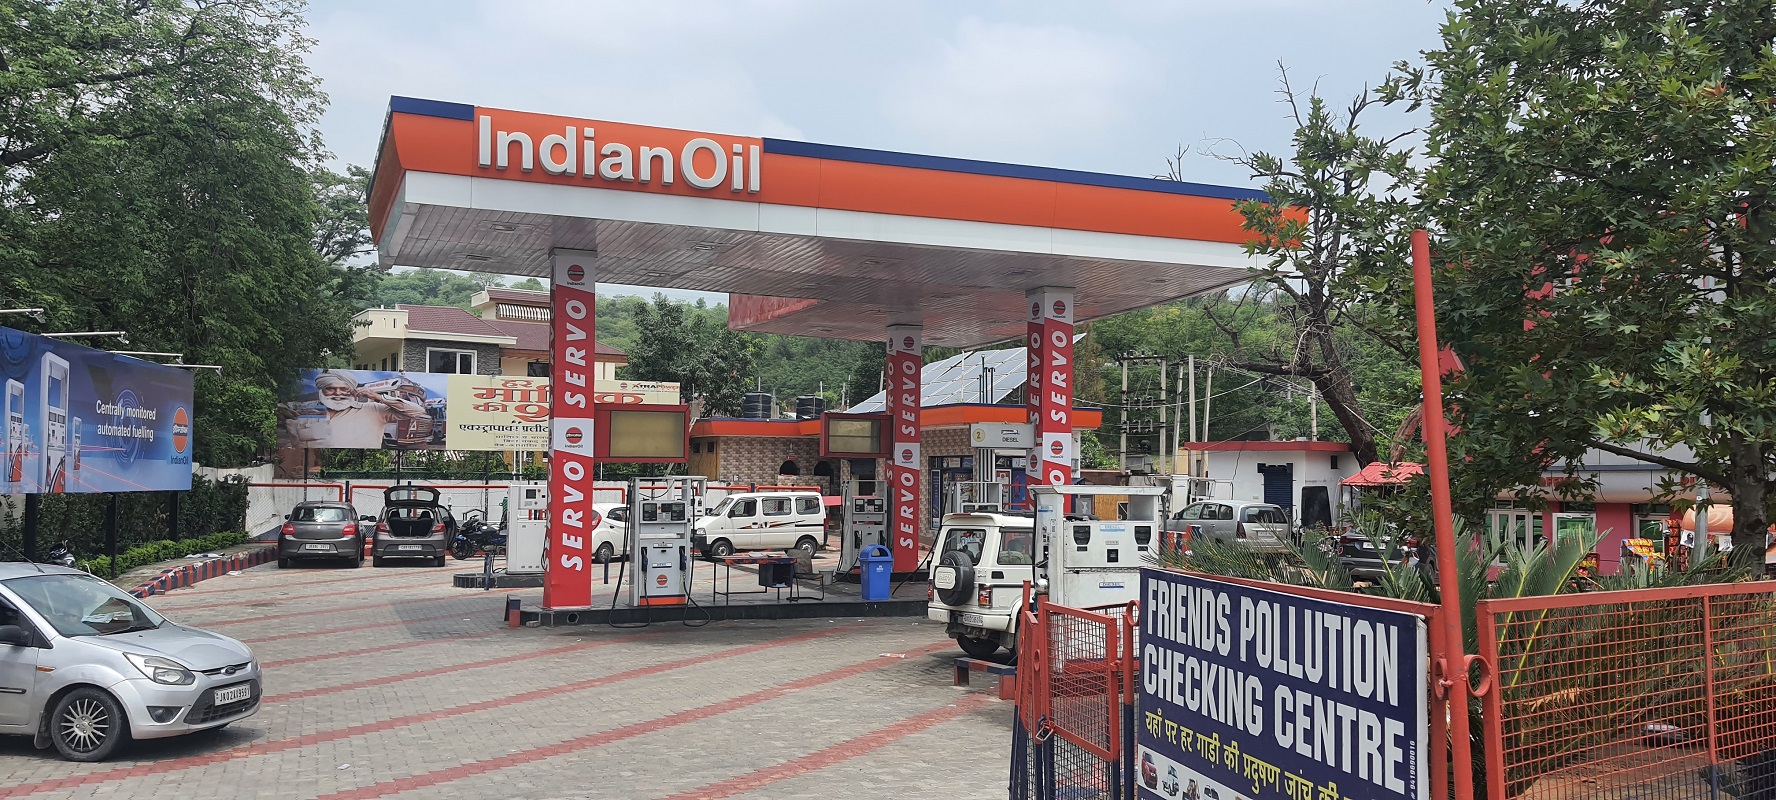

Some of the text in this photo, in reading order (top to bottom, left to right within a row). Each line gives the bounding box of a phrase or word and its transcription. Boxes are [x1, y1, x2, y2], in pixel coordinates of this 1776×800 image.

[478, 115, 760, 193] IndianOil
[501, 379, 534, 388] हर
[565, 300, 587, 409] SERVO
[1030, 332, 1041, 425] SERVO
[1051, 330, 1067, 424] SERVO
[96, 400, 156, 420] Centrally monitored
[97, 423, 154, 442] automated fuelling
[472, 401, 509, 412] की
[902, 361, 916, 437] SERVO
[976, 431, 981, 439] 2
[171, 456, 188, 464] IndianOil
[561, 461, 585, 571] SERVO
[900, 472, 915, 549] SERVO
[1148, 578, 1398, 706] FRIENDS POLLUTION
[1144, 643, 1405, 794] CHECKING CENTRE
[1165, 719, 1178, 745] पर
[1180, 725, 1194, 752] हर
[1196, 732, 1221, 769] गाड़ी
[1223, 740, 1240, 774] की
